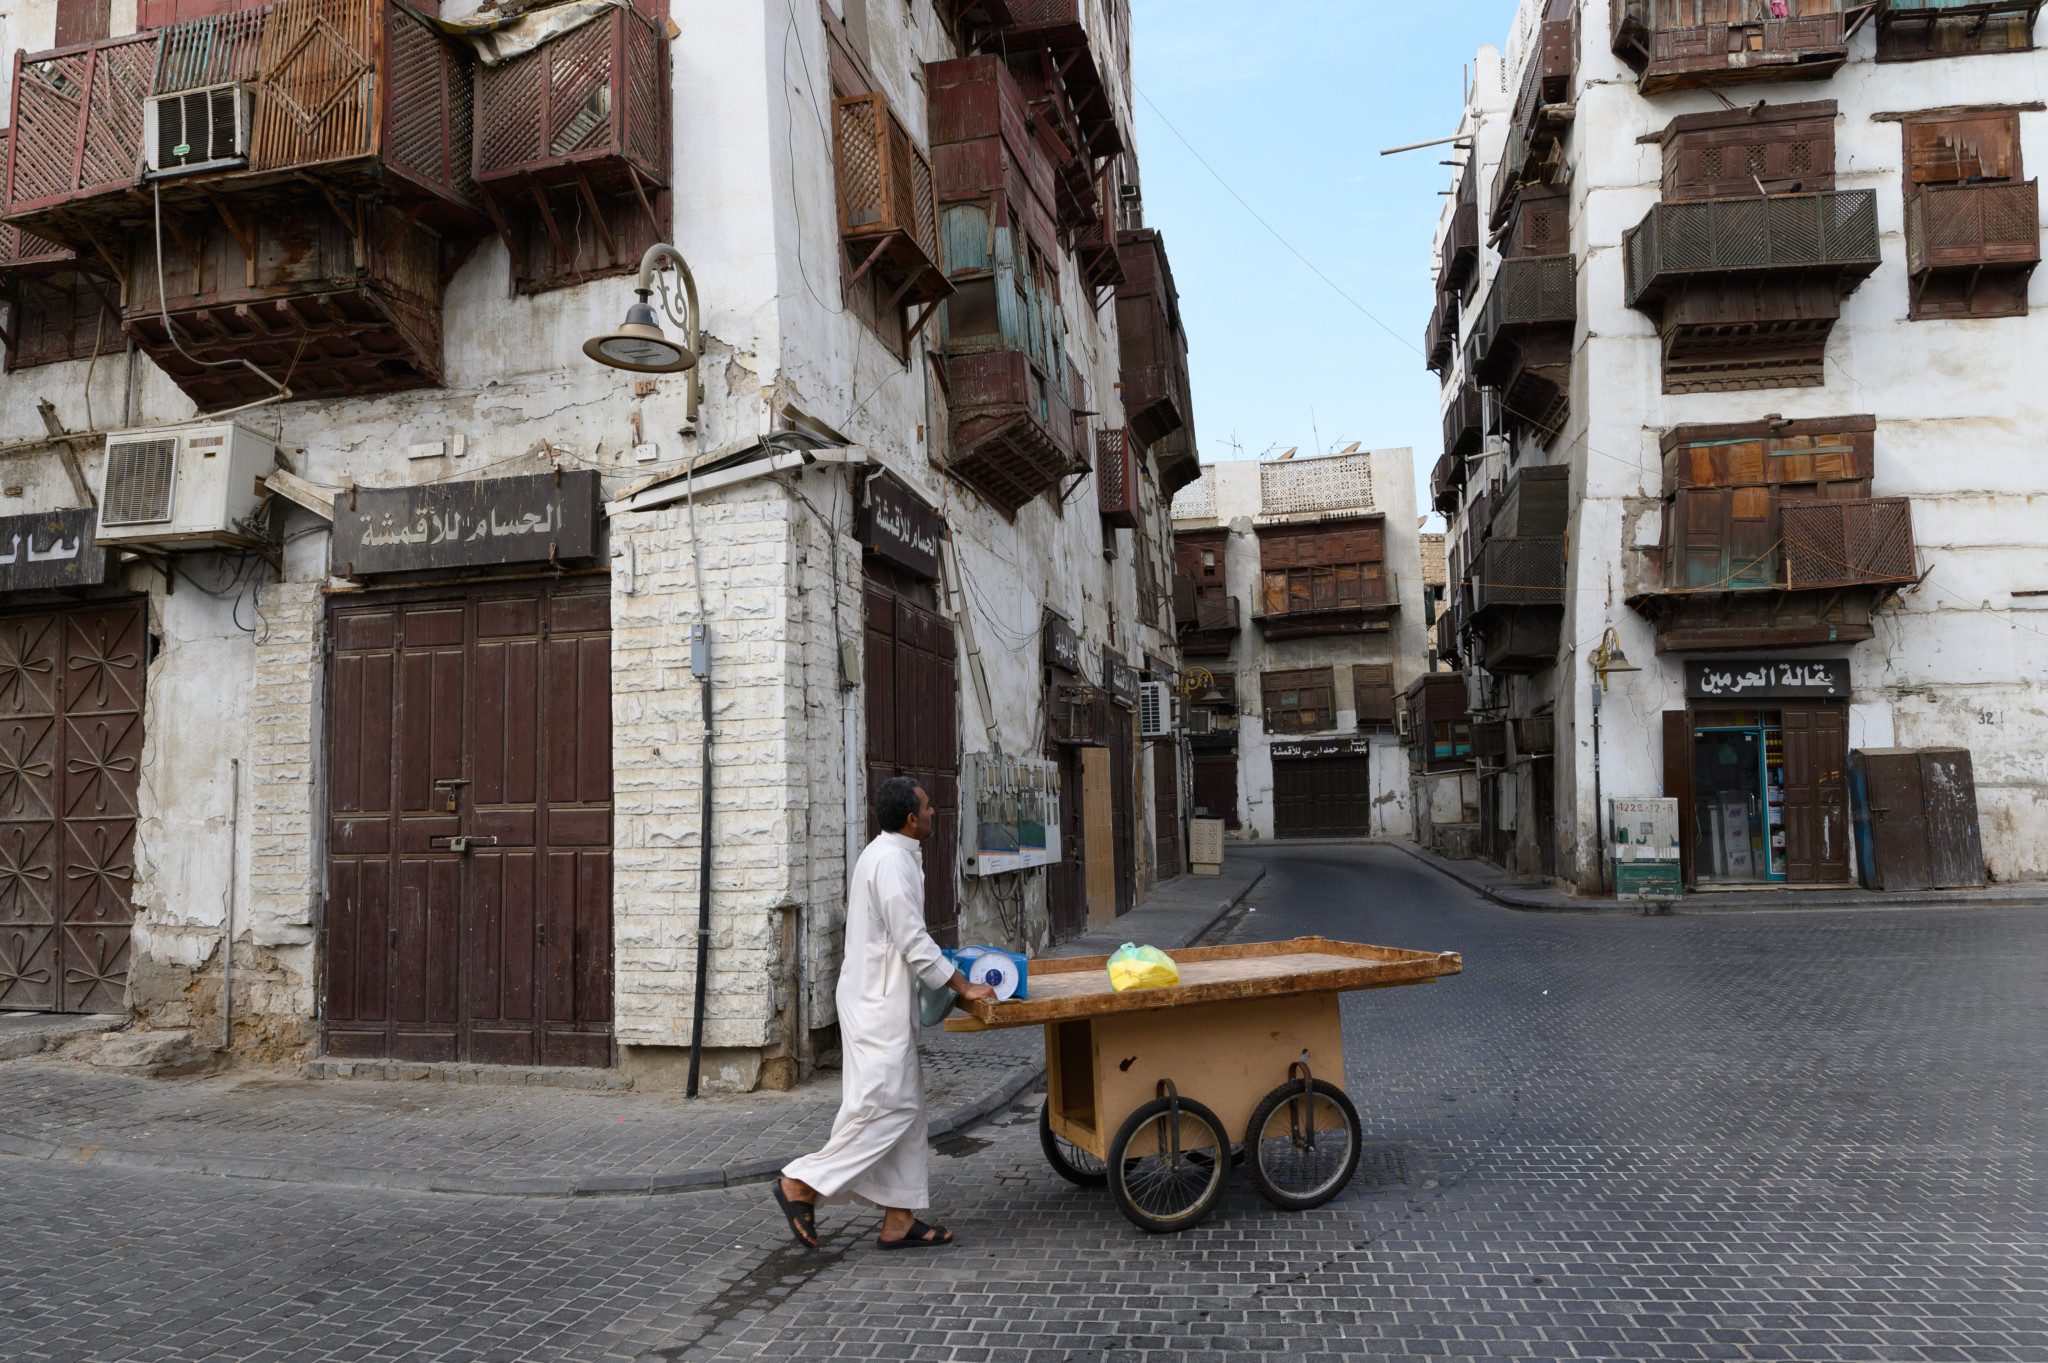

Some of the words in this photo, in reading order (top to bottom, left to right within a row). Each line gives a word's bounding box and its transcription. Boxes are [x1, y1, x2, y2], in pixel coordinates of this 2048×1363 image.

[465, 503, 561, 543] الحسام
[910, 524, 937, 558] الحسام
[1701, 666, 1776, 694] الحرمين
[1779, 664, 1835, 694] بقالة
